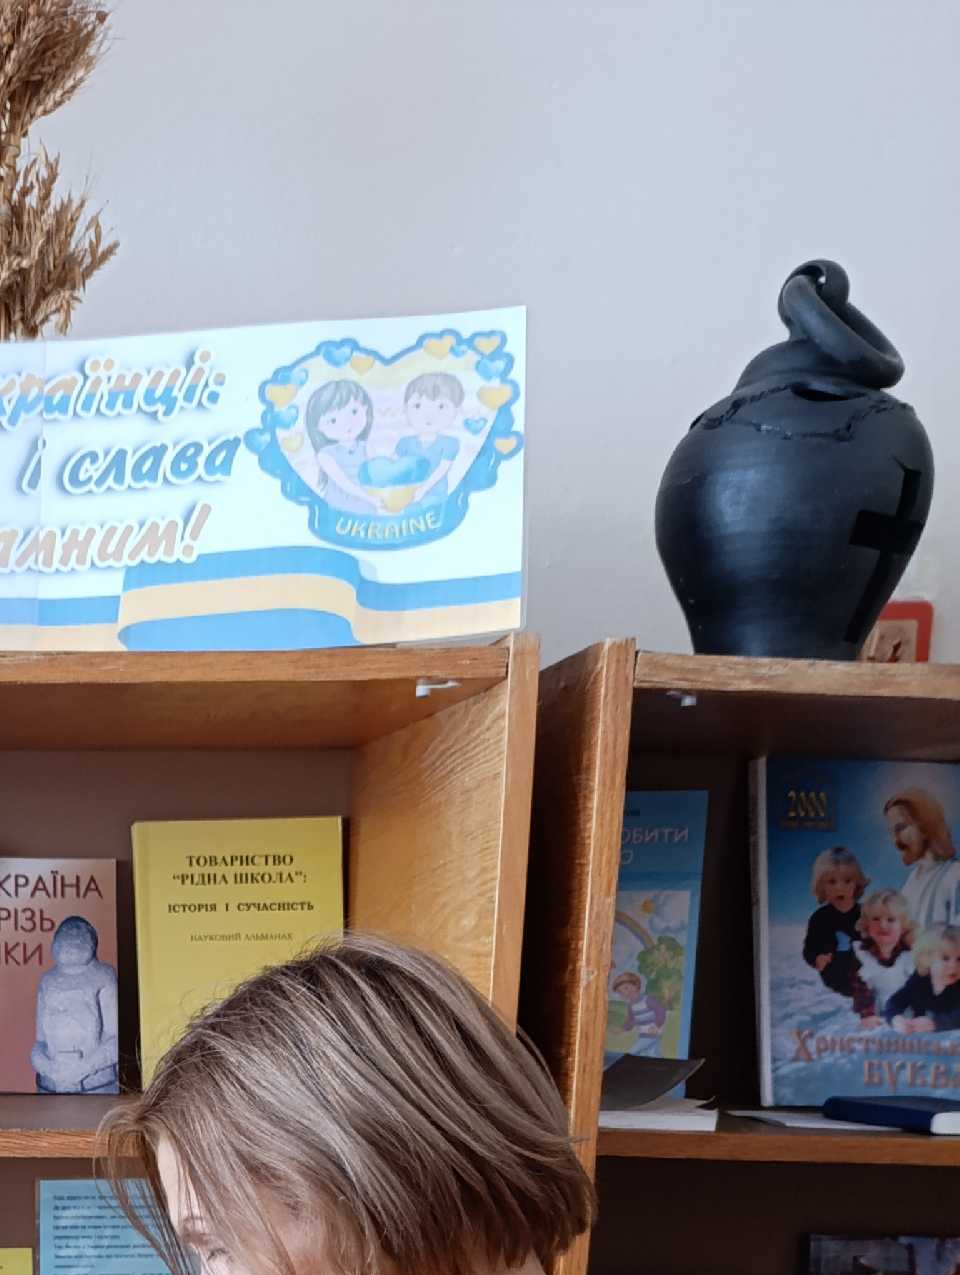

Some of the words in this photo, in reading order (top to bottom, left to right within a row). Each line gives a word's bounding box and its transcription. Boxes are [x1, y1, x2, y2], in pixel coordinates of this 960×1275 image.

[64, 434, 242, 492] слава
[335, 512, 441, 540] UKRAINE
[185, 854, 294, 868] ТОВАРИСТВО
[168, 903, 217, 913] ІСТОРІЯ
[237, 901, 314, 912] СУЧАСНІСТЬ
